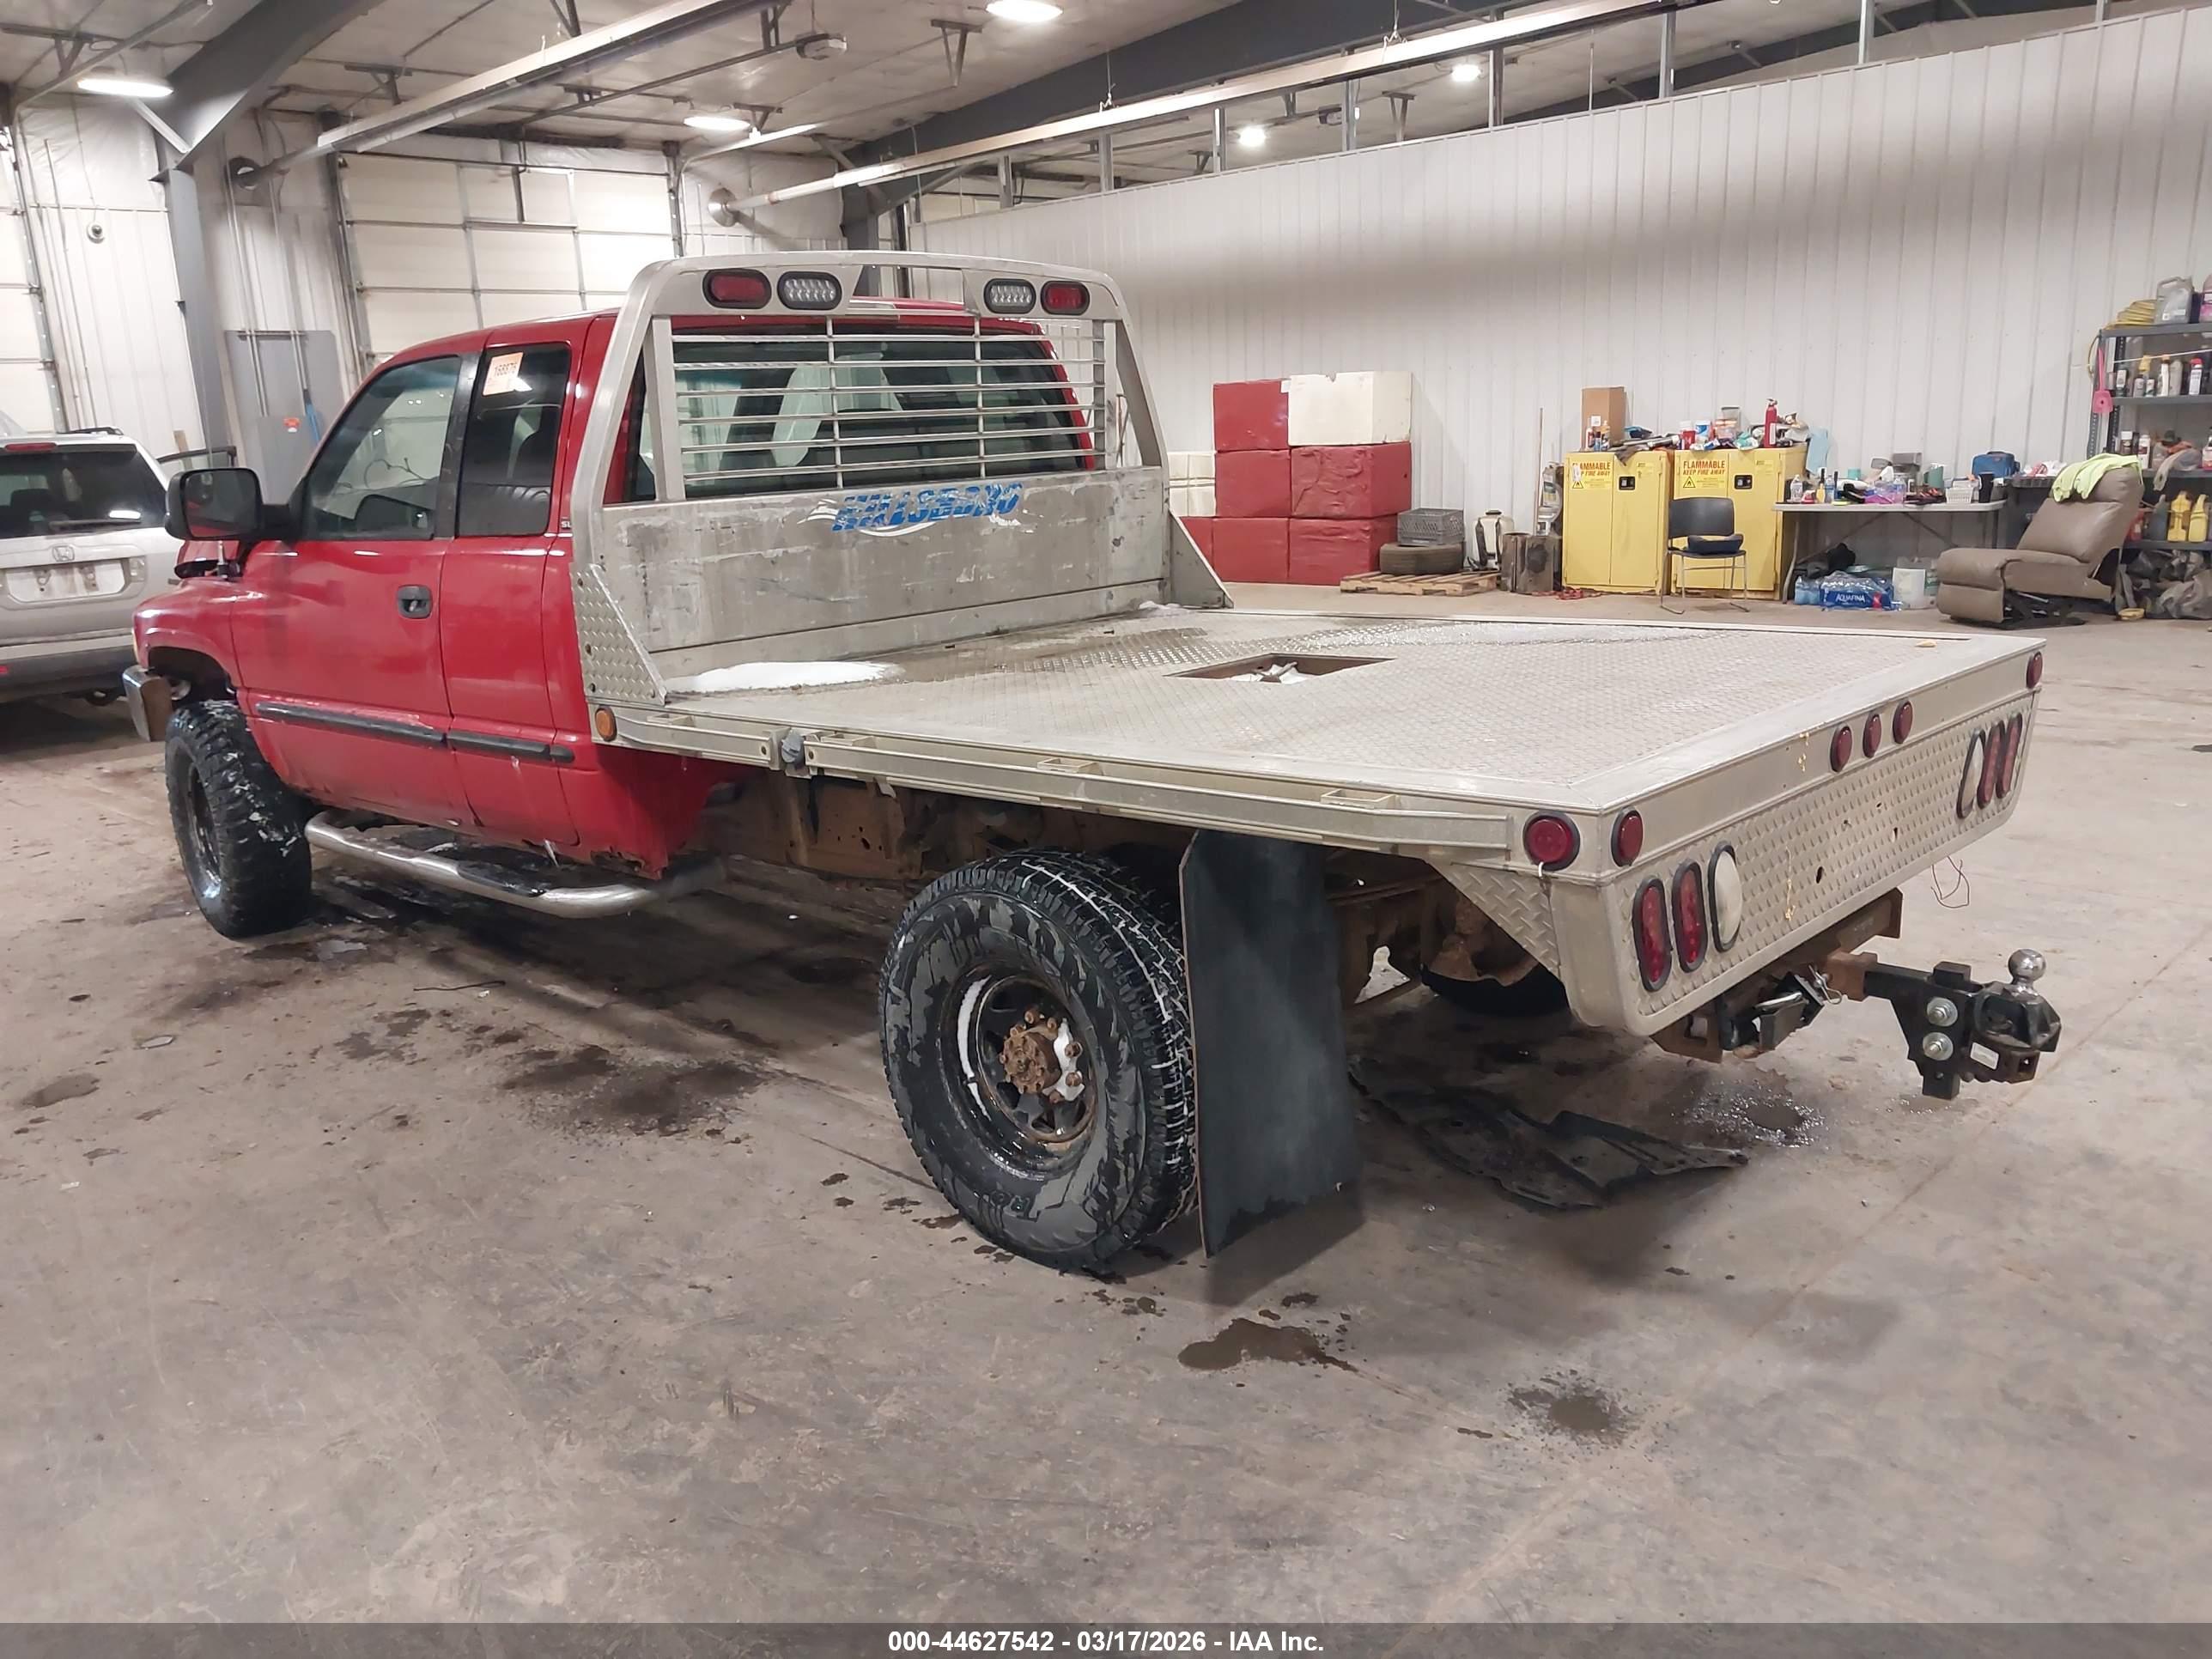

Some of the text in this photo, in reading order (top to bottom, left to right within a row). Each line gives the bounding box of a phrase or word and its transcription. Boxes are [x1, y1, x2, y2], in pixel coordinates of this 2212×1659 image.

[1572, 462, 1611, 471] AMMABLE
[1683, 460, 1725, 469] FLAMMABLE
[1835, 593, 1865, 603] AQUAFINA
